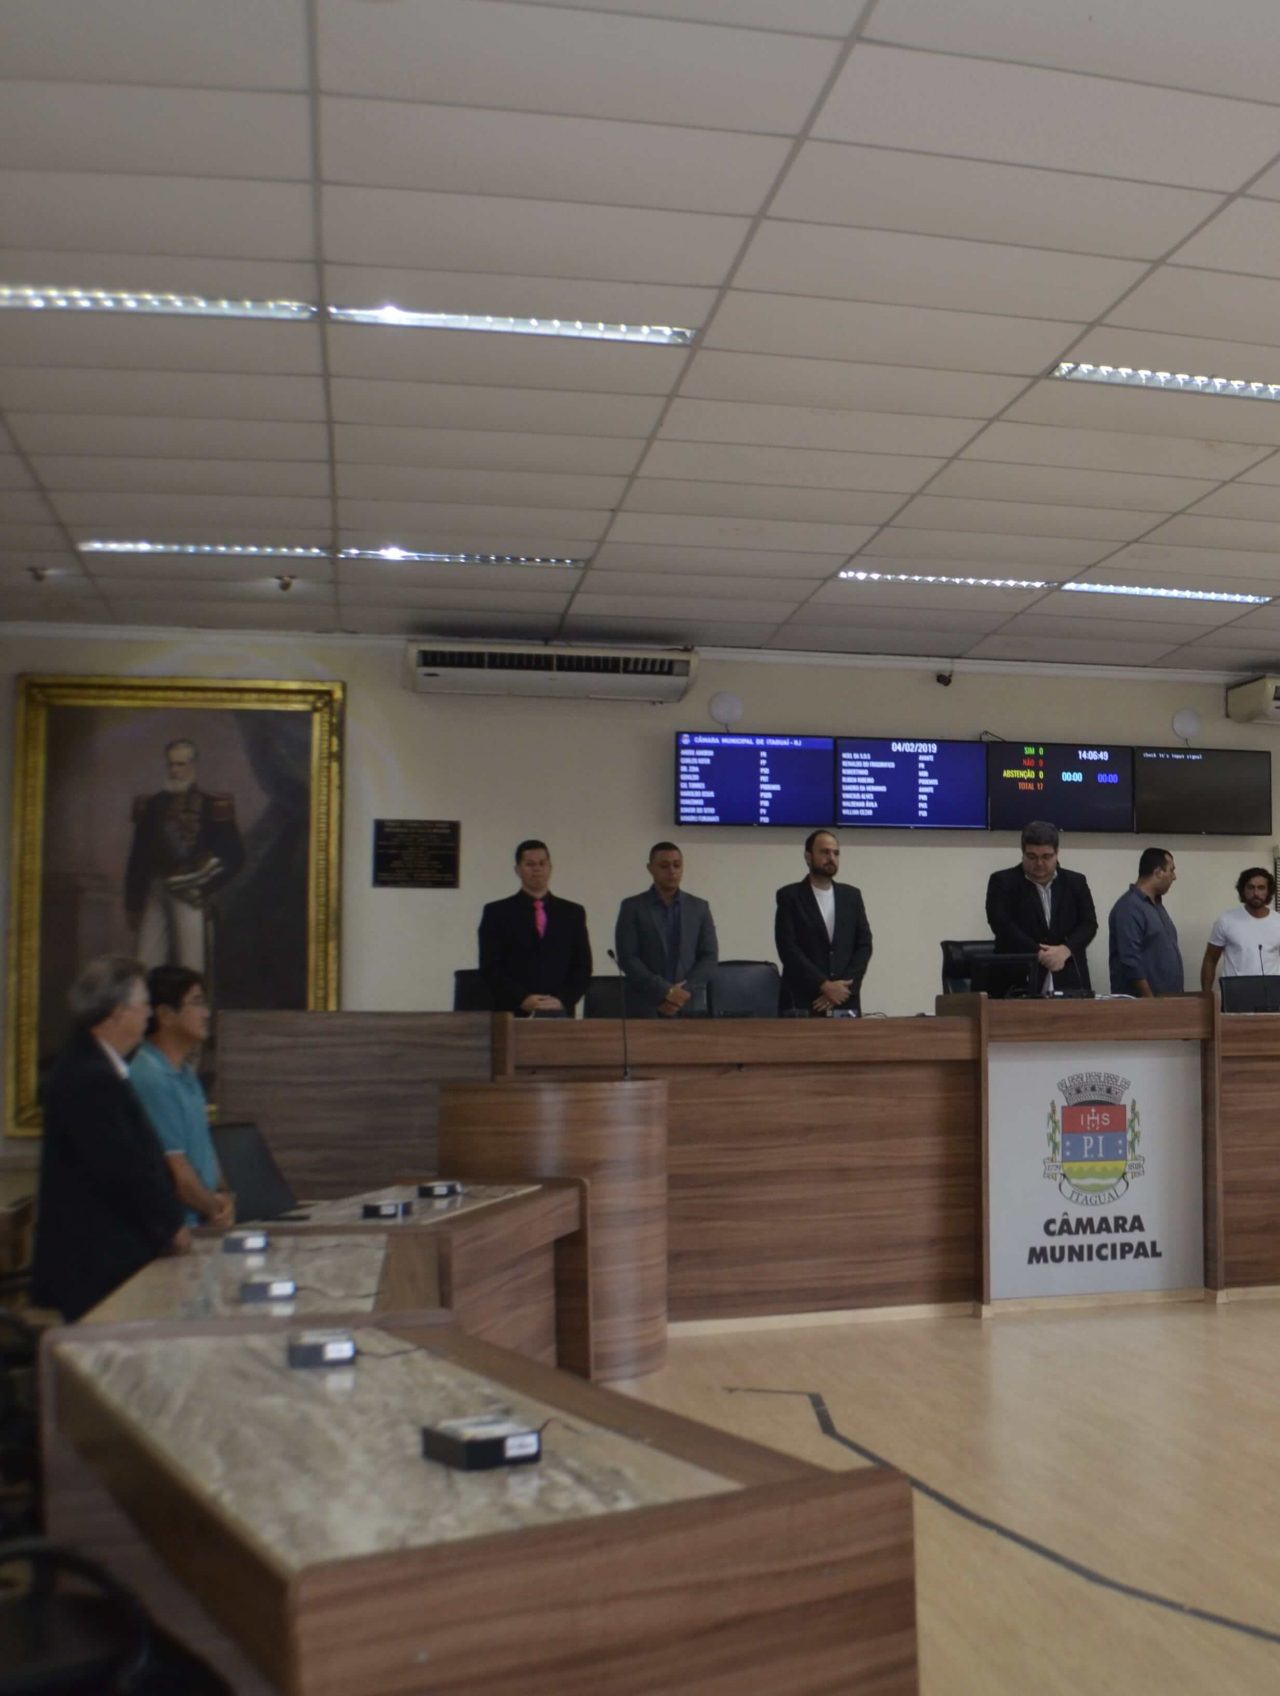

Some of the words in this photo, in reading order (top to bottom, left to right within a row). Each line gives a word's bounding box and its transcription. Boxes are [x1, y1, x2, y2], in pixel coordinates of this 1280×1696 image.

[891, 742, 937, 753] 04/02/2019
[1024, 747, 1035, 755] SIM
[1039, 747, 1044, 755] 0
[1078, 750, 1109, 761] 14:06:49
[1023, 758, 1035, 767] NÃO
[1003, 769, 1035, 780] ABSTENÇÃO
[1039, 771, 1044, 779] 0
[1062, 772, 1083, 782] 00:00
[1098, 774, 1118, 784] 00:00
[1018, 782, 1034, 790] TOTAL
[1043, 1212, 1145, 1236] CÂMARA
[1028, 1240, 1162, 1264] MUNICIPAL
